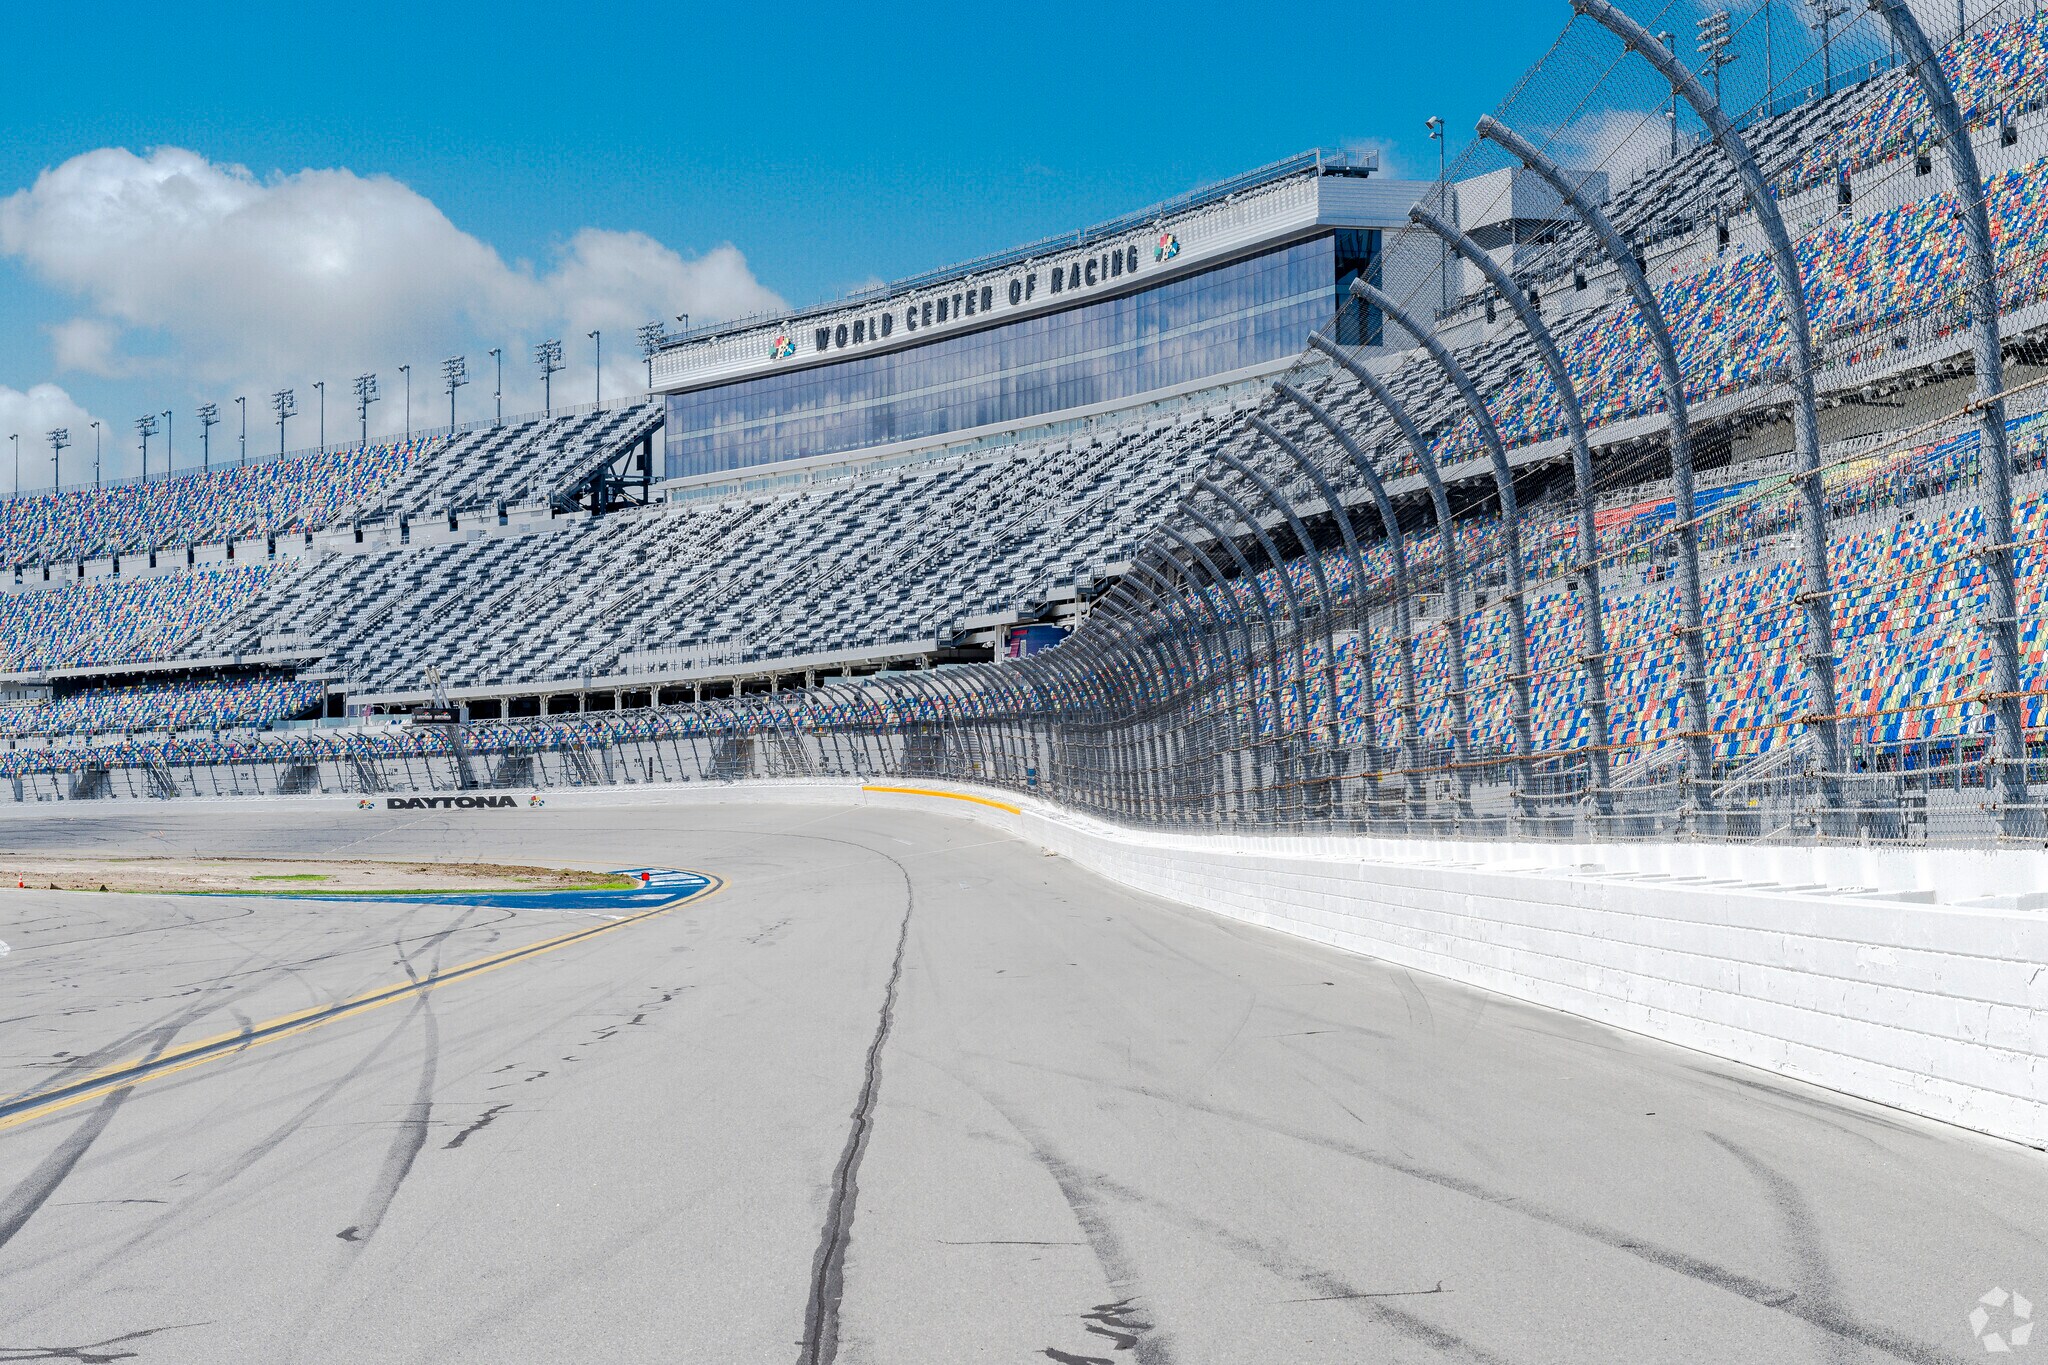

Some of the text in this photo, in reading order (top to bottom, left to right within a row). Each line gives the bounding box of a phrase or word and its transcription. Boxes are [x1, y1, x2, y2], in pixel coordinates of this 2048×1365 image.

[816, 245, 1138, 351] WORLD CENTER OF RACING
[387, 796, 518, 809] DAYTONA
